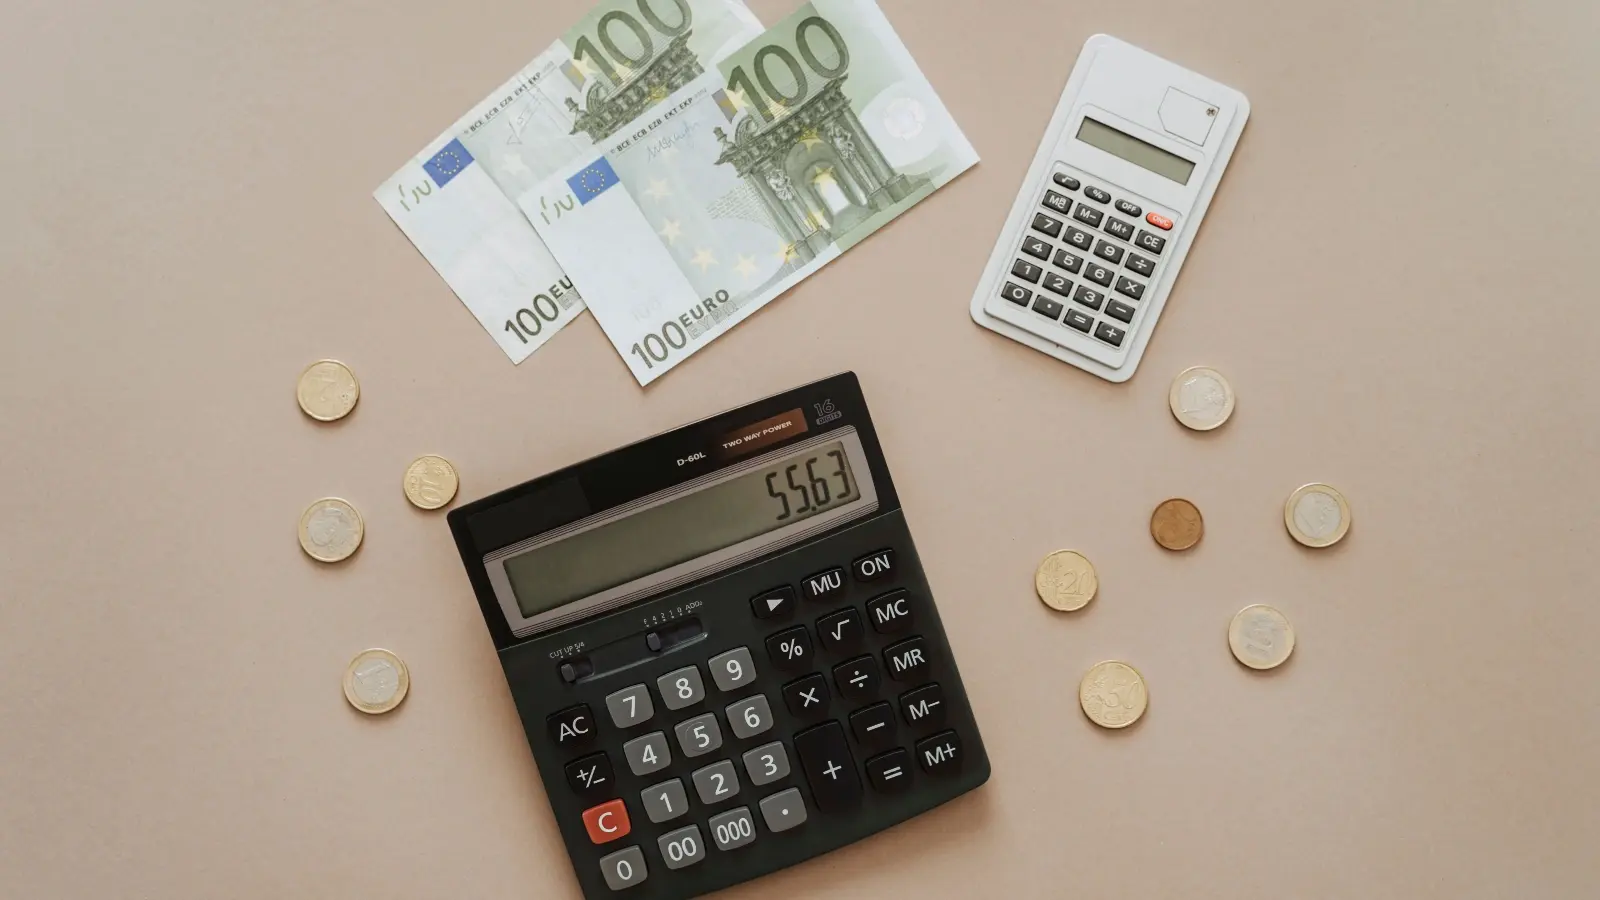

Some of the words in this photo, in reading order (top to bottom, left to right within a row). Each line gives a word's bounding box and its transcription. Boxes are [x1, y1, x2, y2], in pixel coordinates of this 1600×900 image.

[573, 0, 692, 85] 100
[727, 16, 850, 122] 100
[616, 139, 631, 152] BCE
[632, 128, 648, 141] ECB
[648, 118, 662, 130] EZB
[664, 107, 678, 120] EKT
[679, 97, 693, 110] EKP
[1121, 202, 1137, 213] OFF
[1043, 221, 1054, 229] 7
[1072, 232, 1084, 244] 8
[1104, 245, 1115, 257] 9
[1111, 221, 1127, 234] M+
[1143, 235, 1160, 248] CE
[1031, 243, 1043, 253] 4
[1063, 255, 1075, 266] 5
[1094, 268, 1105, 280] 6
[1053, 278, 1065, 289] 2
[1084, 291, 1096, 302] 3
[505, 294, 559, 344] 100
[548, 275, 573, 299] EU
[631, 321, 687, 369] 100
[678, 289, 729, 328] EURO
[814, 399, 835, 416] 16
[722, 438, 743, 449] TWO
[743, 431, 761, 442] WAY
[762, 420, 792, 435] POWER
[676, 451, 706, 467] D-60L
[810, 572, 841, 596] MU
[861, 554, 891, 577] ON
[876, 599, 909, 623] MC
[550, 649, 563, 659] CUT
[622, 695, 636, 718] 7
[675, 678, 693, 699] 8
[726, 659, 743, 681] 9
[893, 648, 925, 672] MR
[558, 716, 589, 742] AC
[642, 744, 658, 765] 4
[693, 725, 710, 748] 5
[744, 706, 760, 728] 6
[660, 792, 673, 813] 1
[710, 773, 729, 795] 2
[760, 754, 778, 776] 3
[925, 743, 956, 767] M+
[598, 811, 617, 833] C
[616, 859, 633, 880] 0
[667, 836, 697, 862] 00
[717, 817, 751, 844] 000
